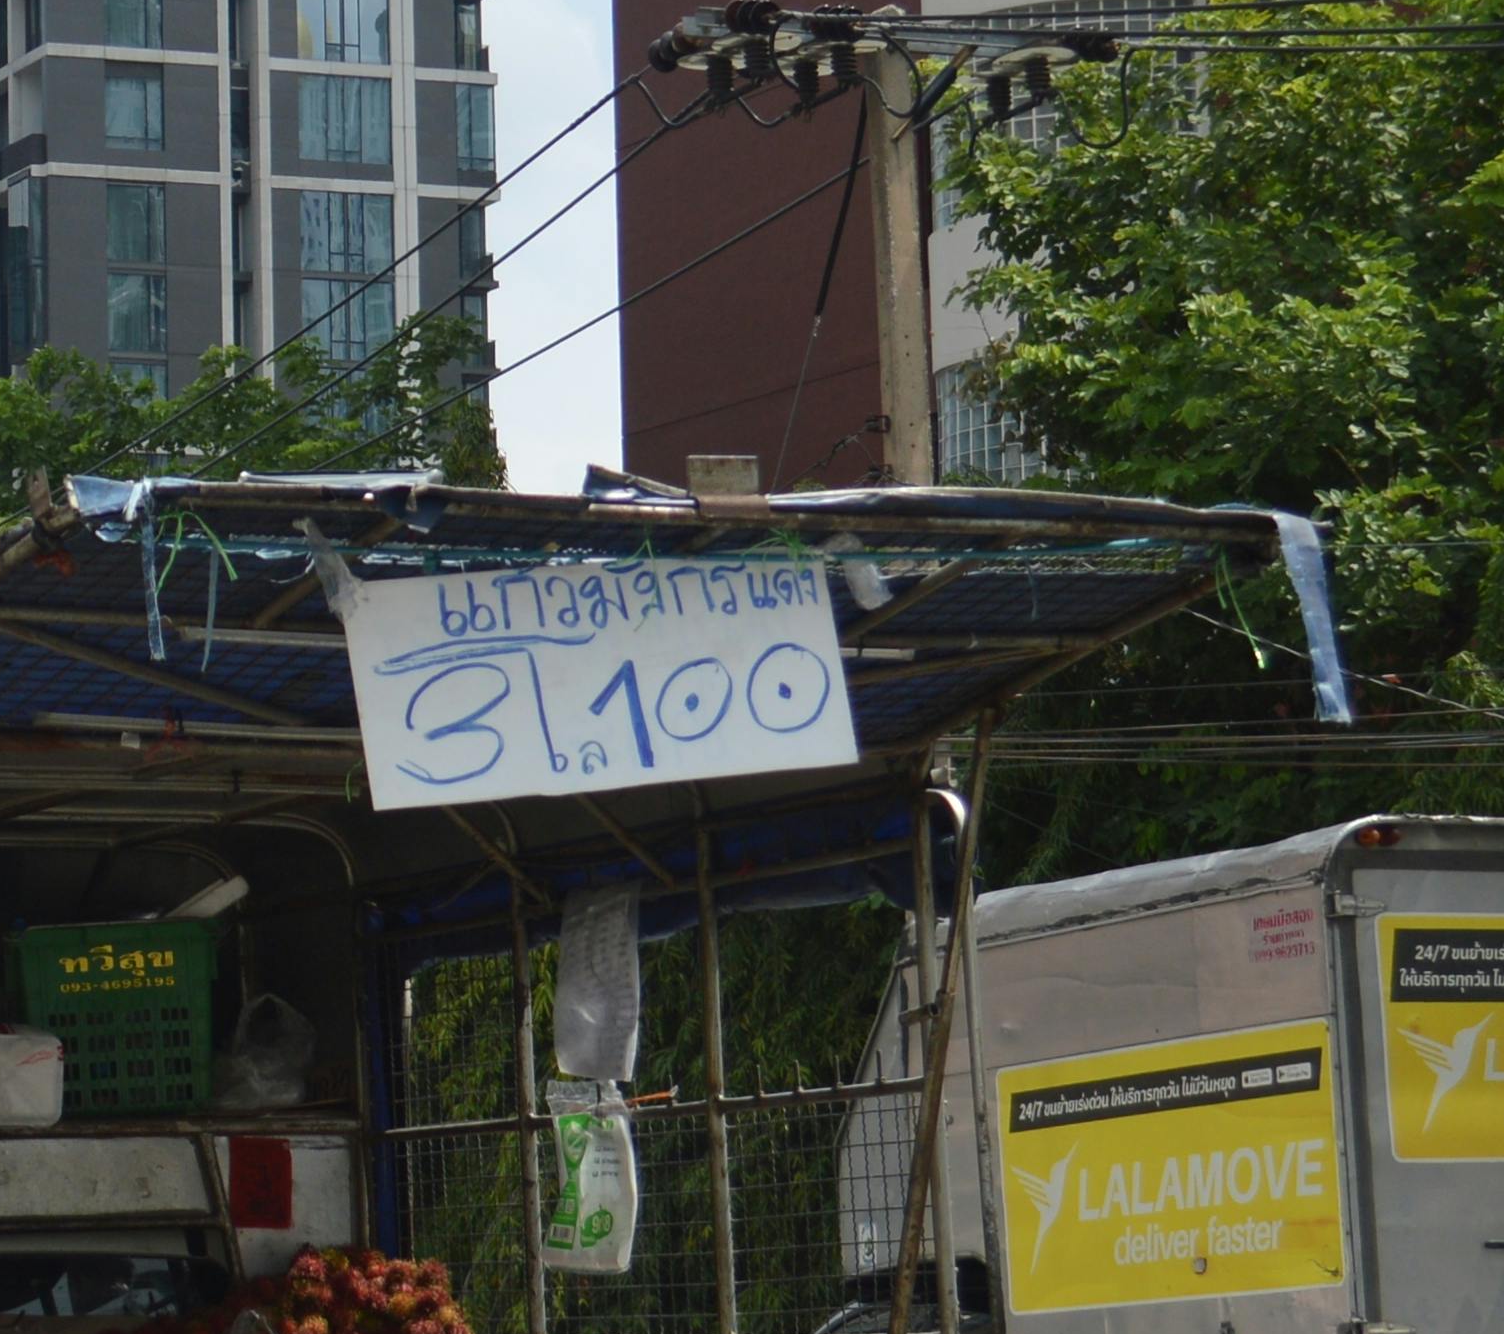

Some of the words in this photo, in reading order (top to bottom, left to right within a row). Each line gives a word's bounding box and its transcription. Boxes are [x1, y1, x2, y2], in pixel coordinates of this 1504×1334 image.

[588, 641, 832, 769] 100
[1414, 944, 1450, 963] 24/7
[1019, 1100, 1044, 1122] 24/7
[1078, 1139, 1325, 1221] LALAMOVE
[1114, 1226, 1200, 1265] deliver
[1208, 1216, 1283, 1256] faster
